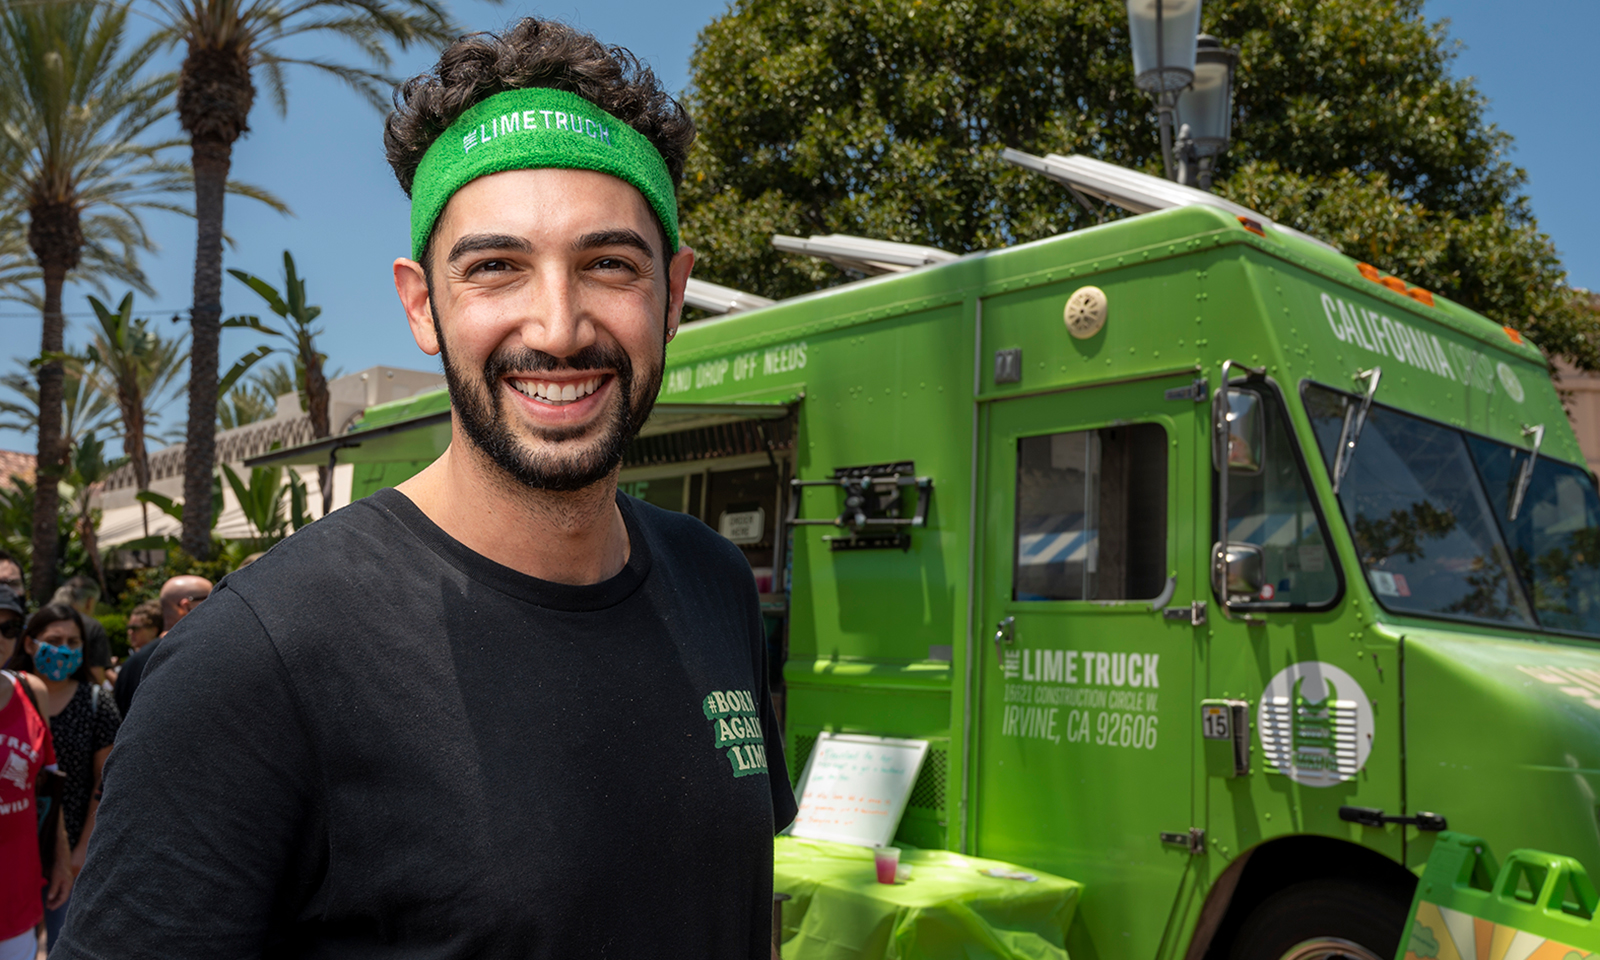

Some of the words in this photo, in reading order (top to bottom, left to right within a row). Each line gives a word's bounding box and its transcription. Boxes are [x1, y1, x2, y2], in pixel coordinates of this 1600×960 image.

[1320, 292, 1456, 381] CALIFORNIA
[667, 367, 692, 394] AND
[696, 358, 729, 389] DROP
[733, 352, 758, 381] OFF
[763, 342, 807, 376] NEEDS
[1004, 649, 1020, 679] THE
[1023, 649, 1078, 683] LIME
[1082, 651, 1159, 688] TRUCK
[707, 690, 756, 714] #BORN
[1034, 686, 1107, 709] CONSTRUCTION
[1108, 690, 1143, 711] CIRCLE
[1002, 704, 1061, 745] IRVINE,
[1067, 709, 1090, 743] CA
[1095, 711, 1158, 750] 92606
[1206, 715, 1227, 736] 15
